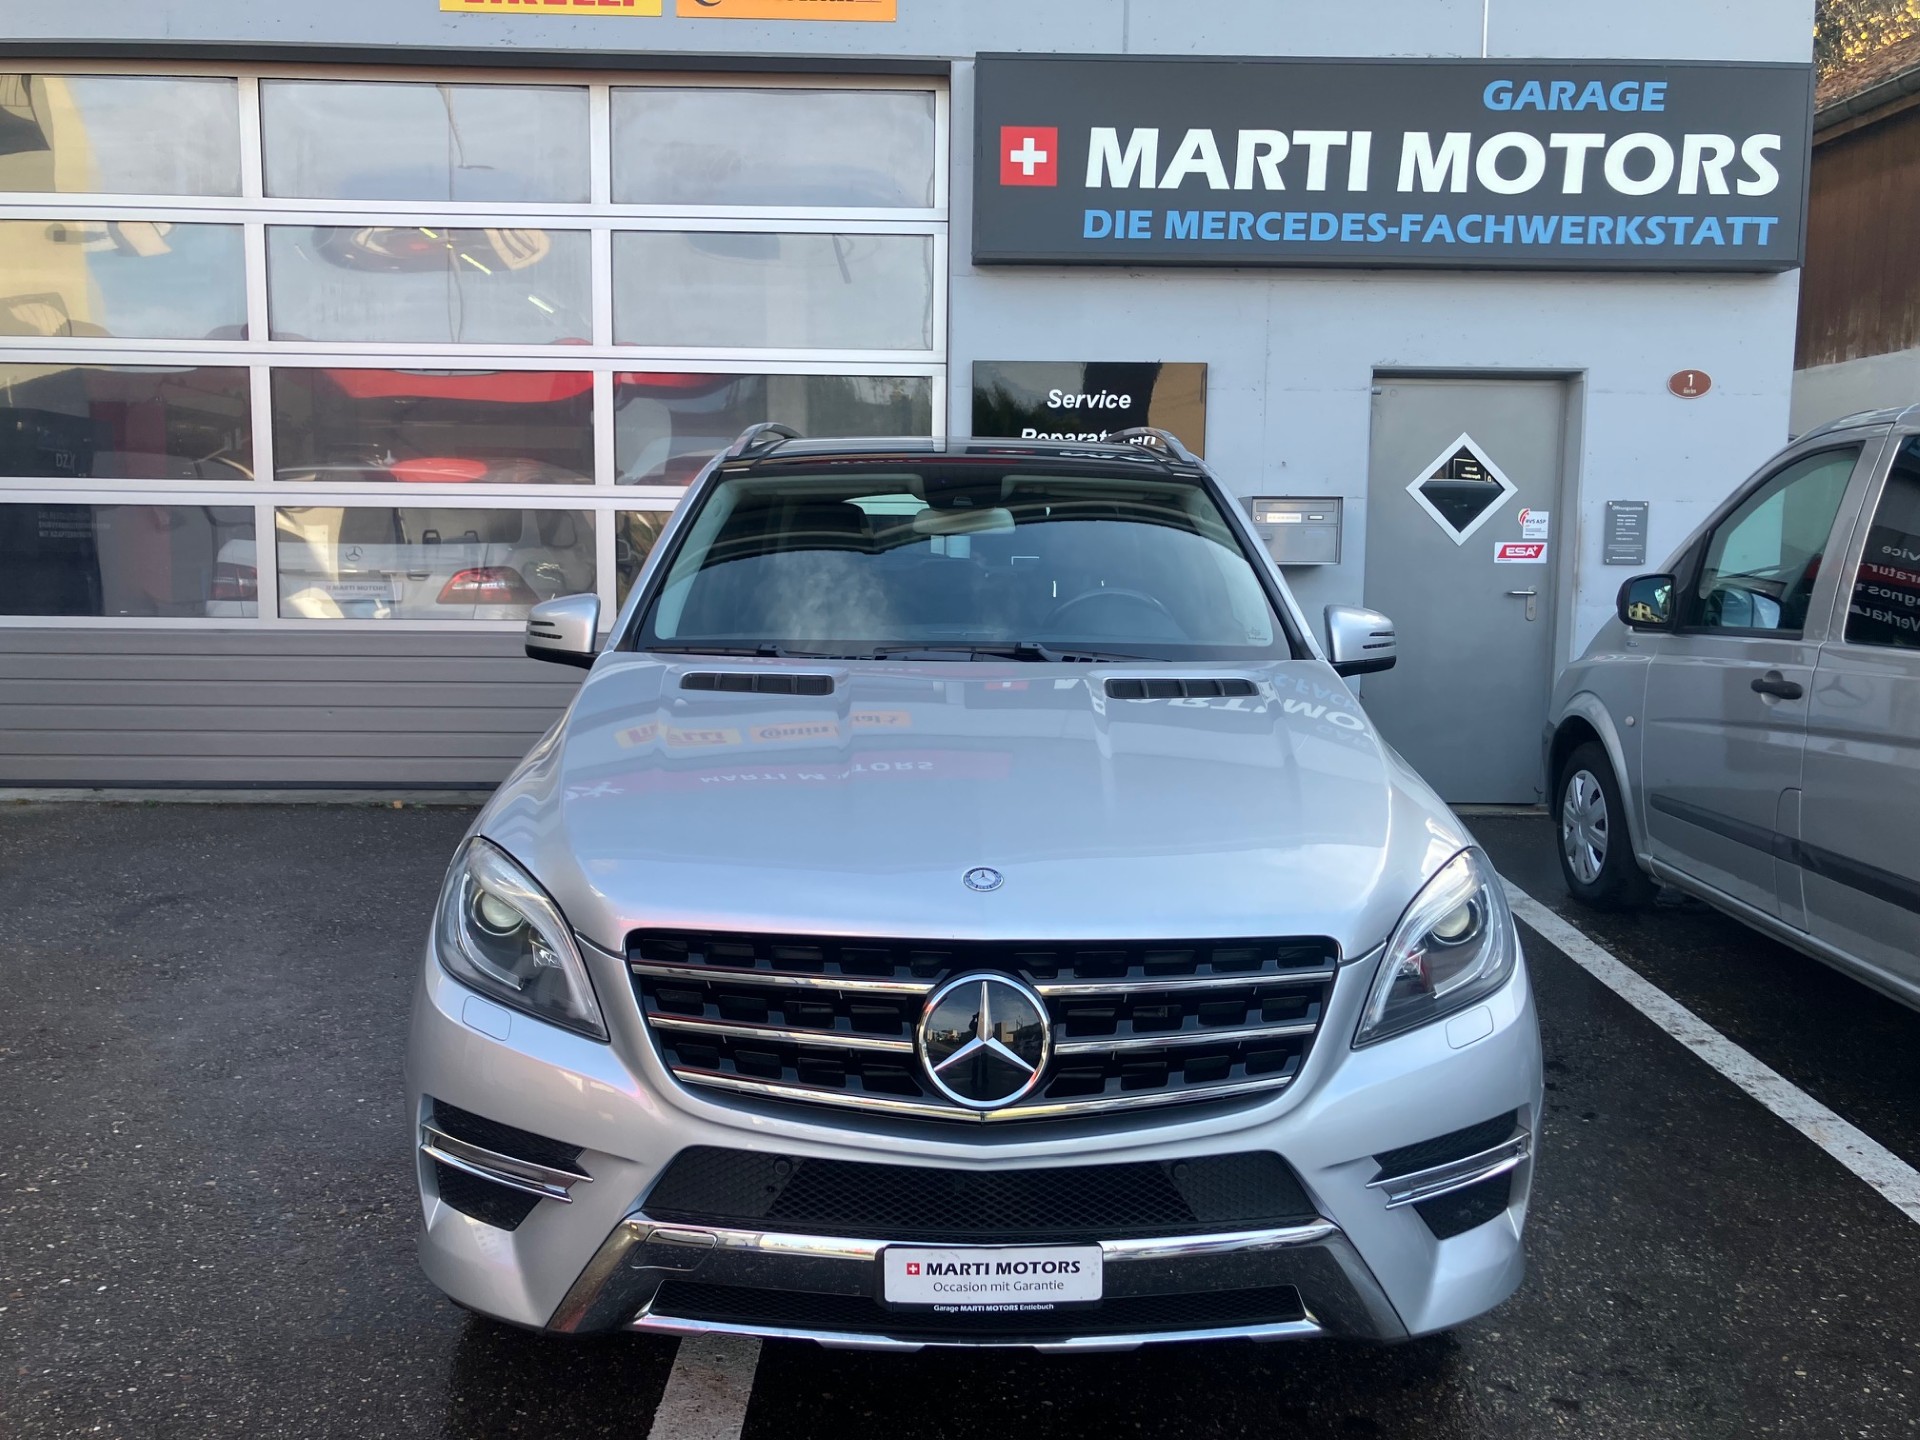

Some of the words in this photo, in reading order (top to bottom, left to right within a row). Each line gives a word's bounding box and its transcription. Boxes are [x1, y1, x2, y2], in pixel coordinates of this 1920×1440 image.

[1482, 79, 1668, 113] GARAGE
[1085, 126, 1372, 193] MARTI
[1396, 131, 1781, 197] MOTORS
[1082, 207, 1153, 241] DIE
[1163, 209, 1781, 248] MERCEDES-FACHWERKSTATT
[1687, 374, 1694, 387] 1
[1046, 388, 1132, 410] Service
[1506, 547, 1535, 556] ESA
[926, 1263, 990, 1276] MARTI
[995, 1260, 1081, 1275] MOTORS
[933, 1280, 988, 1293] Occasion
[990, 1280, 1010, 1291] mit
[1013, 1279, 1065, 1291] Garantie
[933, 1304, 959, 1313] Garage
[960, 1304, 985, 1312] MARTI
[985, 1304, 1018, 1312] MOTORS
[1019, 1303, 1054, 1311] Entlebuch
